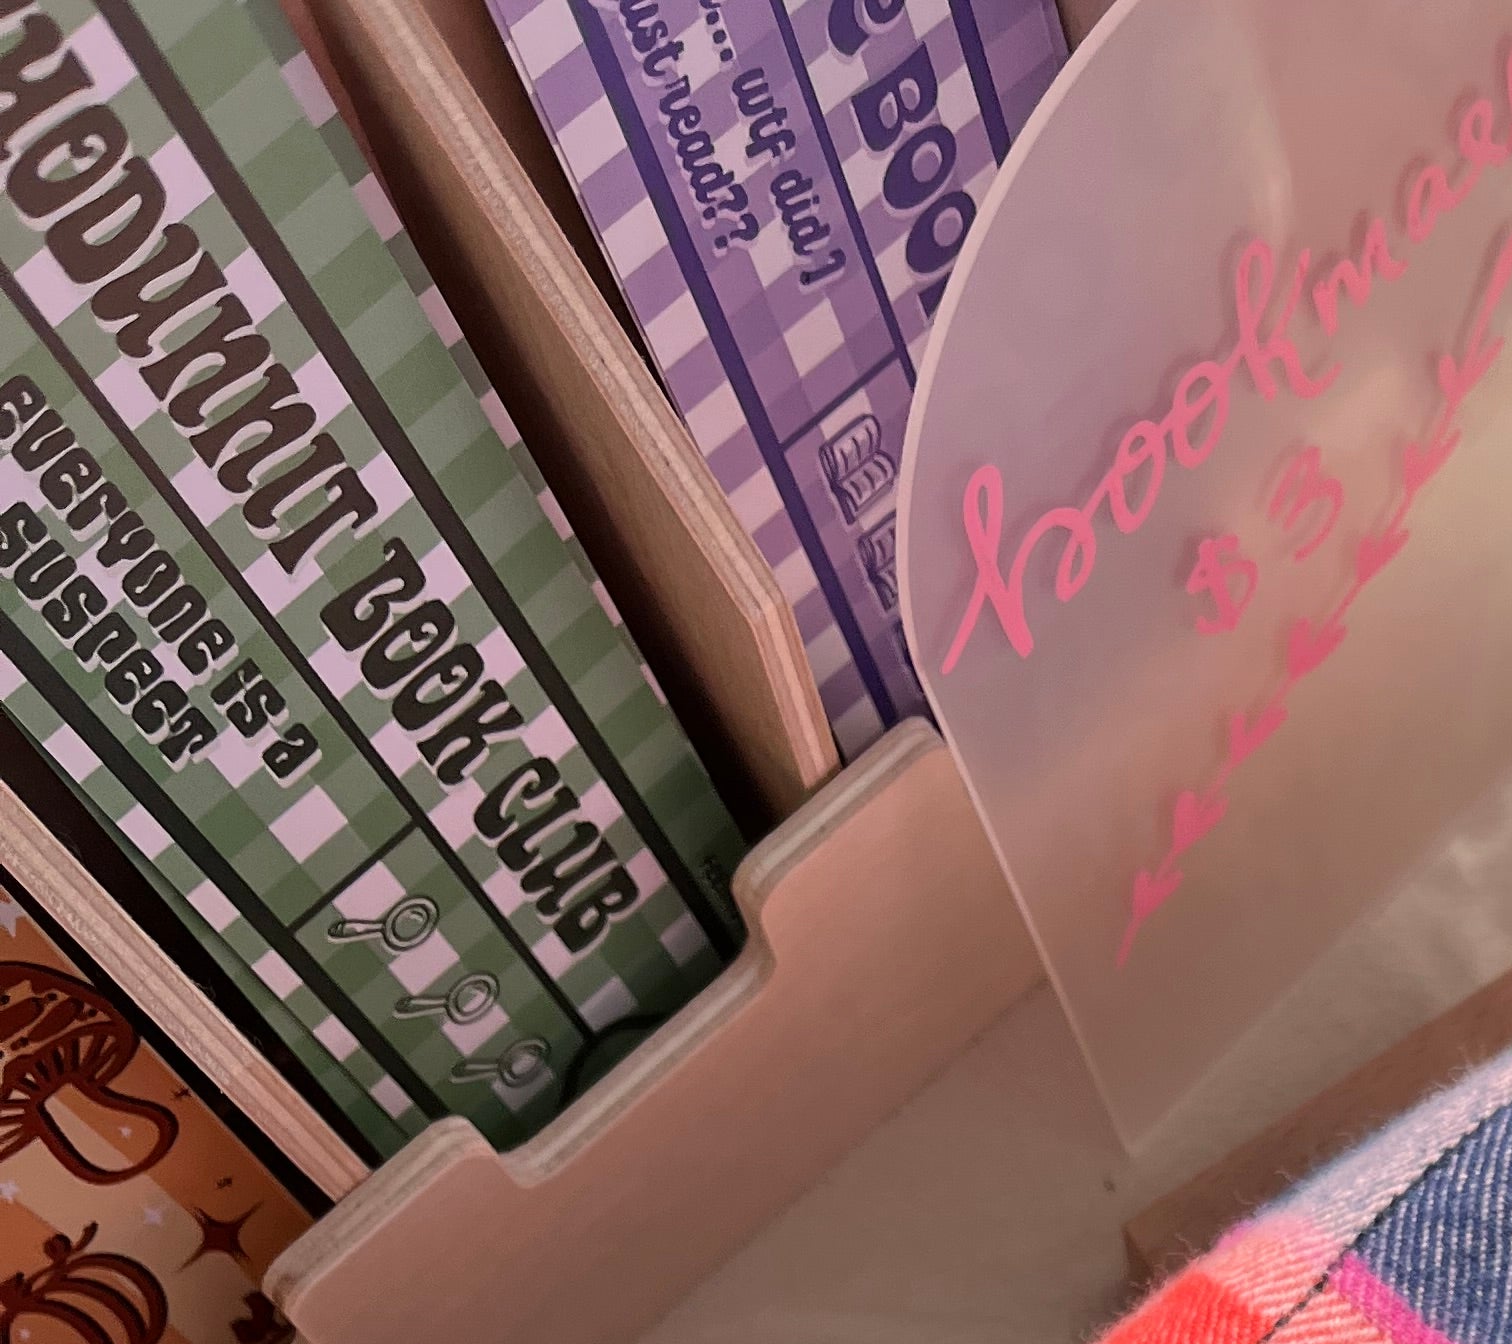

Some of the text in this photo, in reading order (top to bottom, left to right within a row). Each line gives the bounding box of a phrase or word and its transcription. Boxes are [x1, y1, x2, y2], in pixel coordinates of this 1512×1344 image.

[619, 0, 759, 249] ust read??
[732, 67, 796, 158] wtf
[770, 169, 830, 256] did
[852, 41, 977, 319] BOO
[0, 0, 639, 955] HODUNNIT BOOK CLUB
